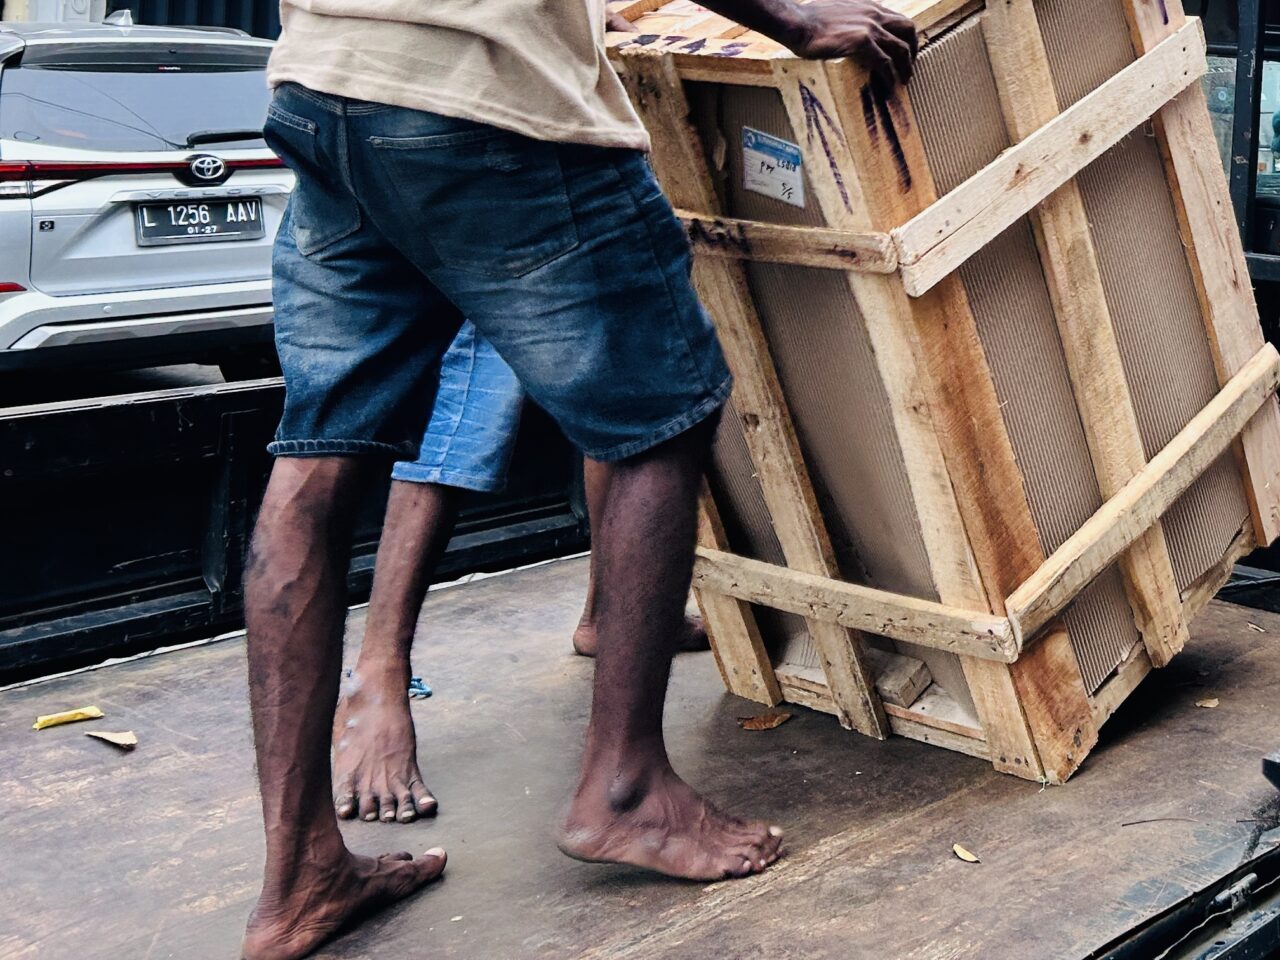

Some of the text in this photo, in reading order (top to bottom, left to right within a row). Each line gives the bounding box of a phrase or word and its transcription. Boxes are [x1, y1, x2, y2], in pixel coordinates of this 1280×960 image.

[142, 202, 257, 228] L 1256 AAV
